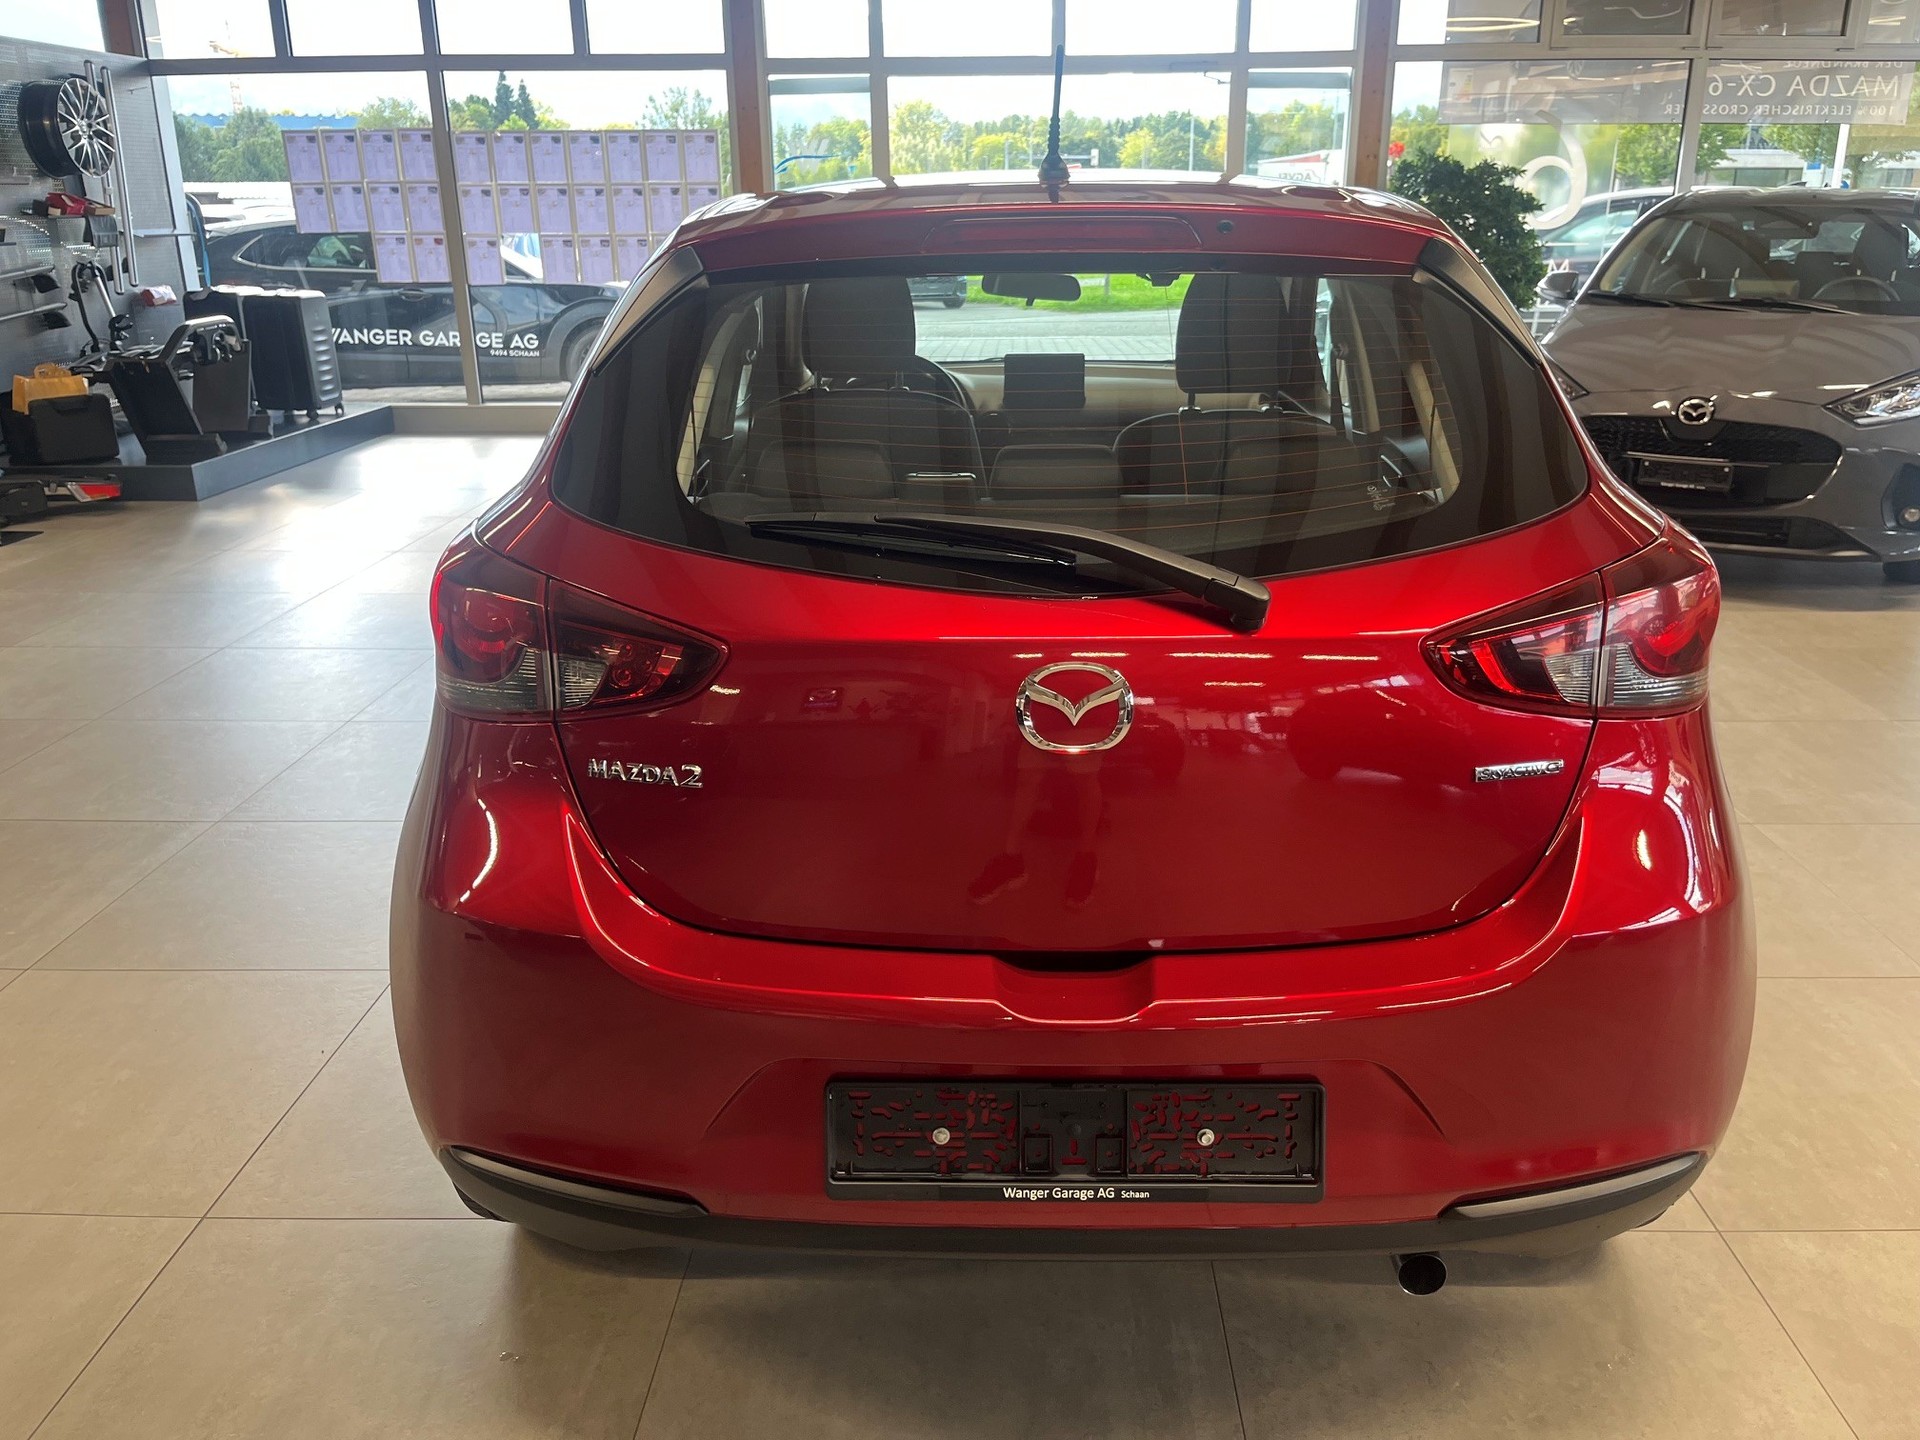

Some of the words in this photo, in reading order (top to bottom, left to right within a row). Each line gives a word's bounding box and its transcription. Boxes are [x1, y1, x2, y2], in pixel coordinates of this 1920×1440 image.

[419, 330, 504, 348] GARGE
[510, 333, 539, 349] AG
[1003, 1187, 1049, 1200] Wanger
[1052, 1187, 1094, 1200] Garage
[1097, 1187, 1115, 1199] AG
[1121, 1190, 1150, 1199] Schaan
